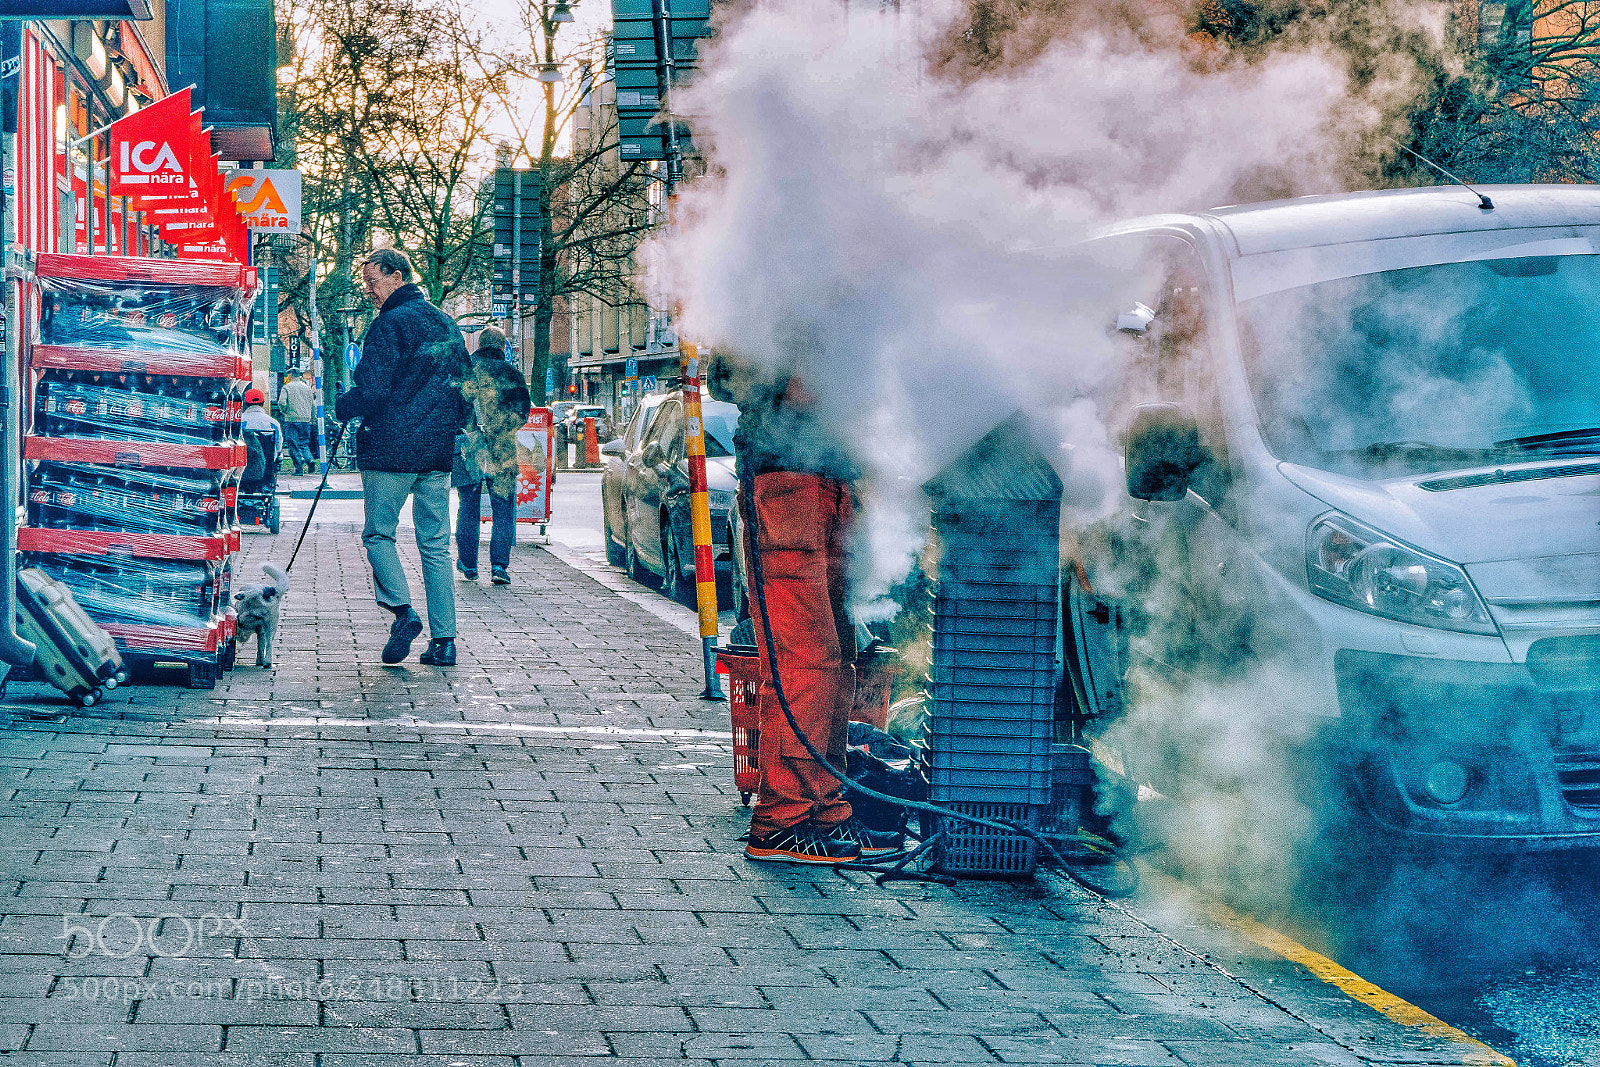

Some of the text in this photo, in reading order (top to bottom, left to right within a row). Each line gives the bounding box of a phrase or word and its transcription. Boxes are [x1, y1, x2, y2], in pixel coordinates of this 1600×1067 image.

[120, 141, 184, 173] ICA
[150, 172, 184, 184] nära
[226, 175, 288, 214] CA
[248, 213, 288, 228] nära
[204, 244, 227, 253] nära
[528, 414, 543, 424] ris!
